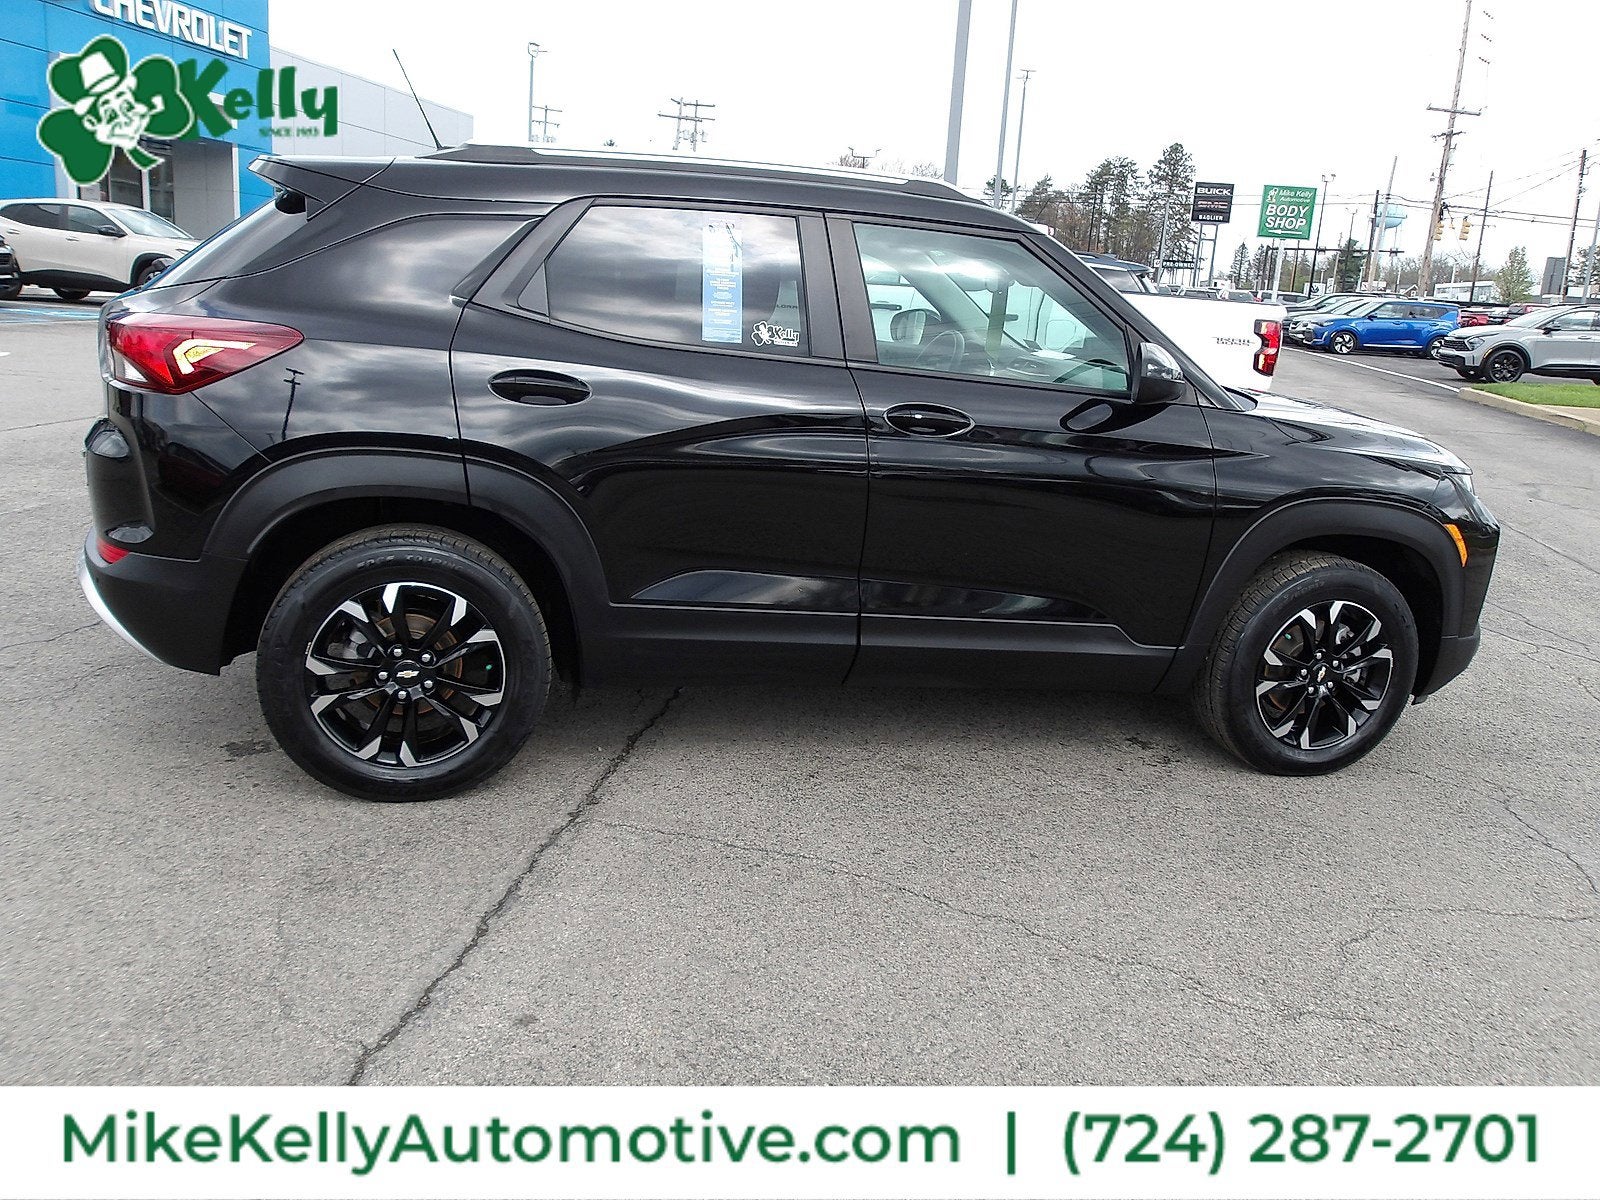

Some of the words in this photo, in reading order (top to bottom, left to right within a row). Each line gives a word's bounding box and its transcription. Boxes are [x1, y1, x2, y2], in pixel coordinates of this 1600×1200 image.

[1197, 187, 1231, 196] BUICK
[1279, 189, 1295, 197] Mike
[1296, 190, 1313, 199] Kelly
[1265, 204, 1311, 217] BODY
[1265, 216, 1307, 230] SHOP
[774, 327, 799, 341] Kelly
